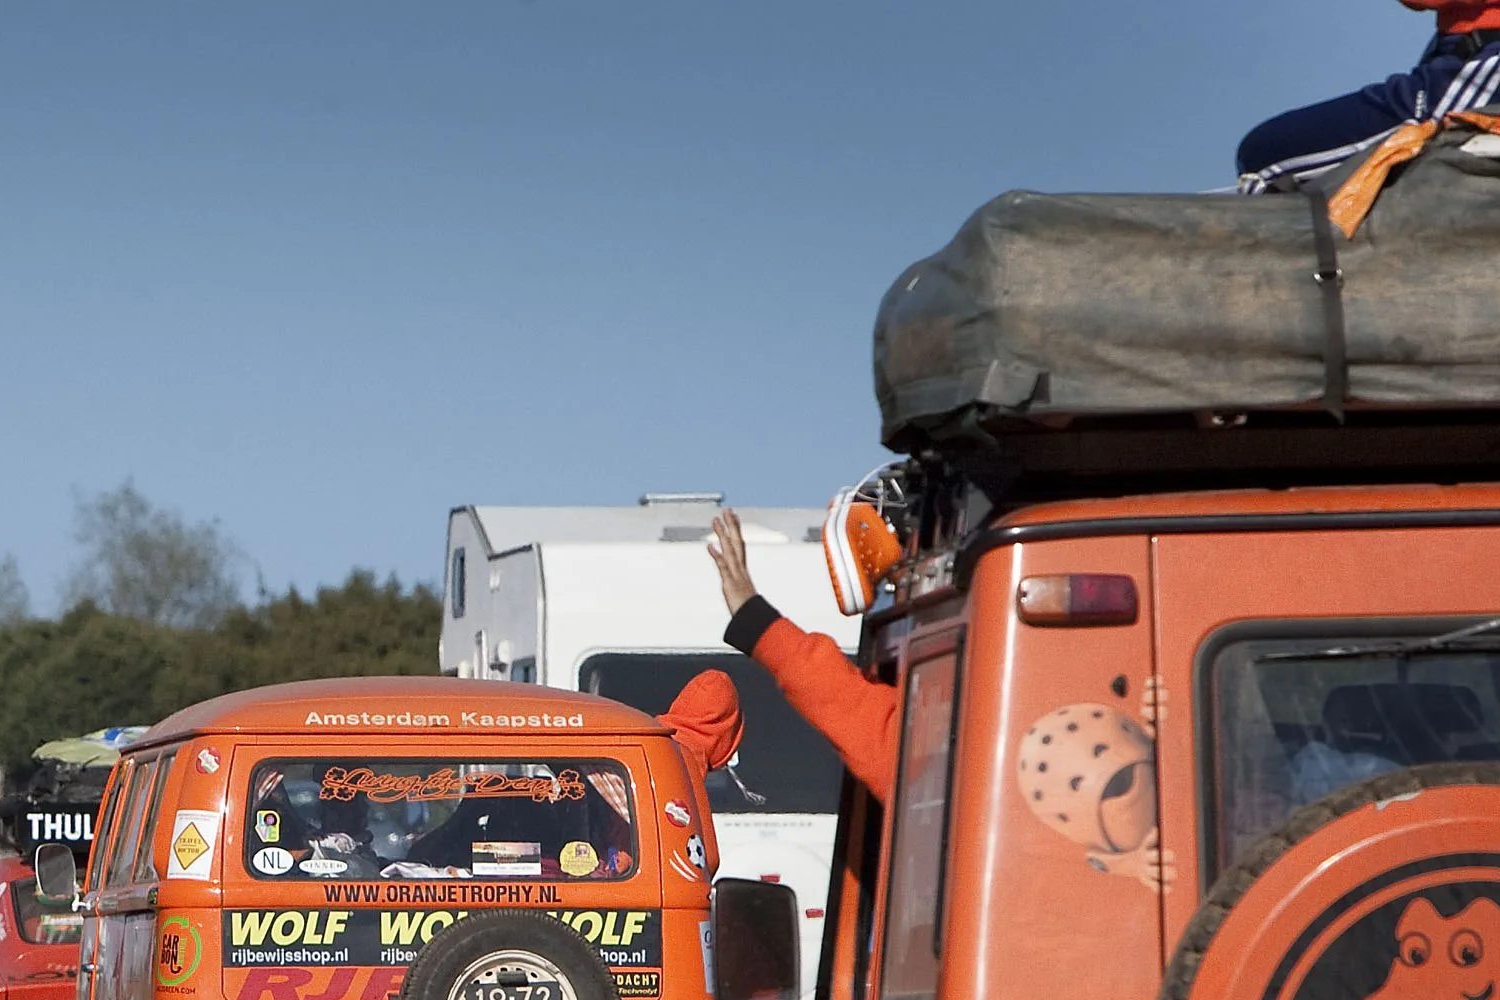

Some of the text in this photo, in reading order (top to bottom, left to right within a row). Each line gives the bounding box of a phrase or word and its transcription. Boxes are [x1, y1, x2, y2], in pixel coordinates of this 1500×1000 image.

[305, 711, 584, 728] Amsterdam Kaapstad
[26, 812, 94, 841] THUL
[262, 851, 287, 870] NL
[324, 885, 562, 903] WWW.ORANJETROPHY.NL
[231, 910, 350, 946] WOLF
[380, 910, 468, 946] WO
[231, 948, 349, 965] rijbewijsshop.nl
[613, 974, 658, 986] DACHT
